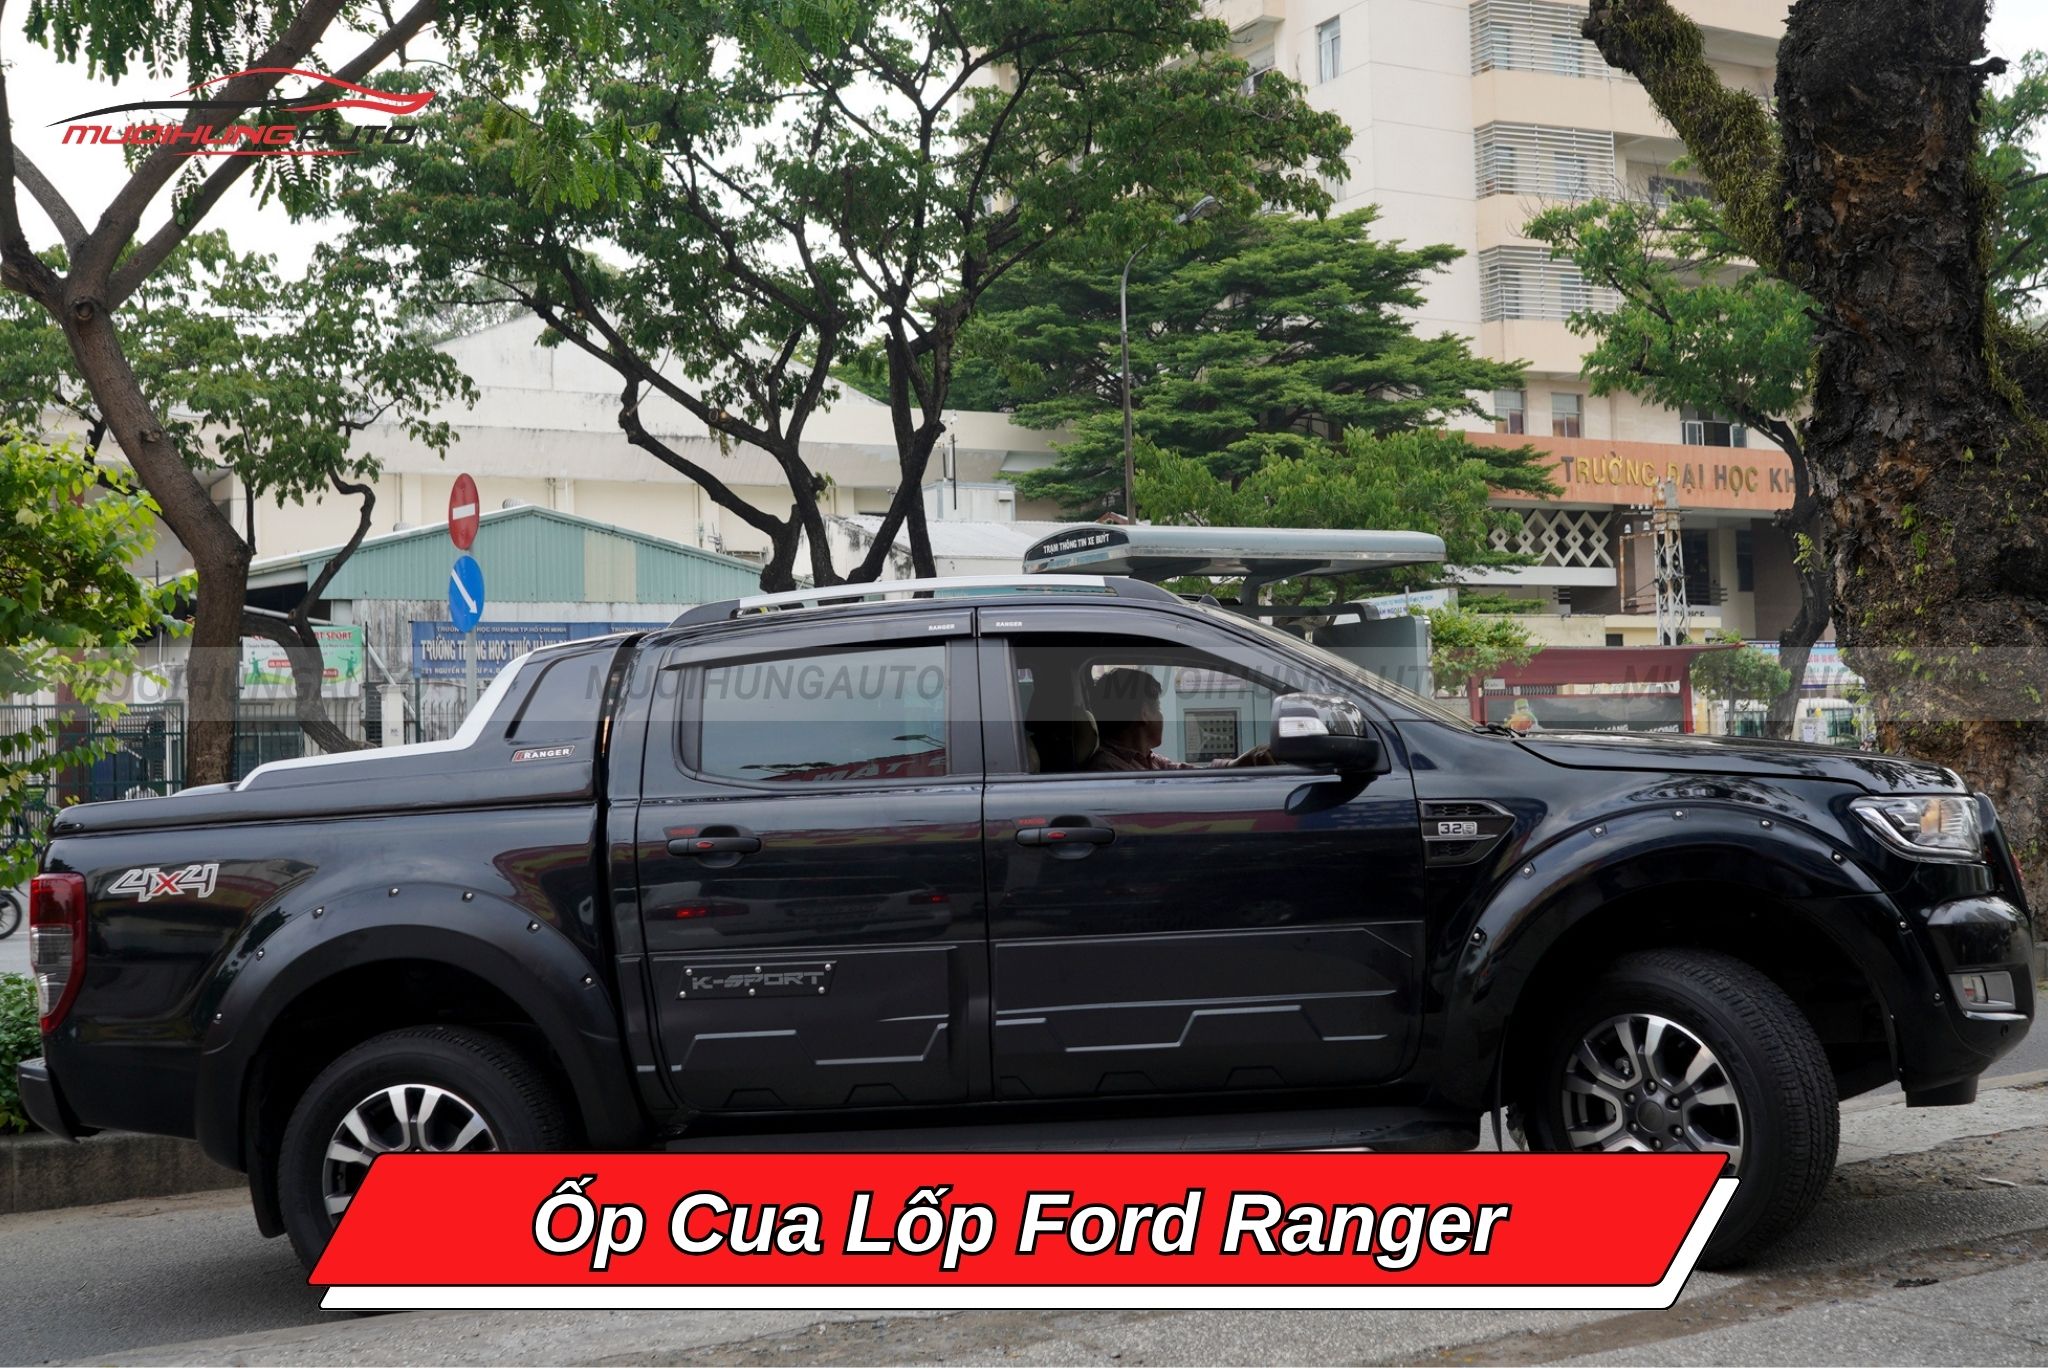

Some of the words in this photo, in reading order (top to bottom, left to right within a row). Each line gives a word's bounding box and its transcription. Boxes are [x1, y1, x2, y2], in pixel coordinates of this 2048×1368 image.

[1561, 450, 1658, 487] TRƯỜNG
[1666, 461, 1704, 494] ĐẠI
[1714, 464, 1759, 498] HỌC
[1088, 536, 1095, 546] XE
[420, 634, 456, 661] TRƯỜNG
[488, 640, 507, 664] HỌC
[523, 748, 570, 759] RANGER
[692, 971, 825, 990] K-SPORT
